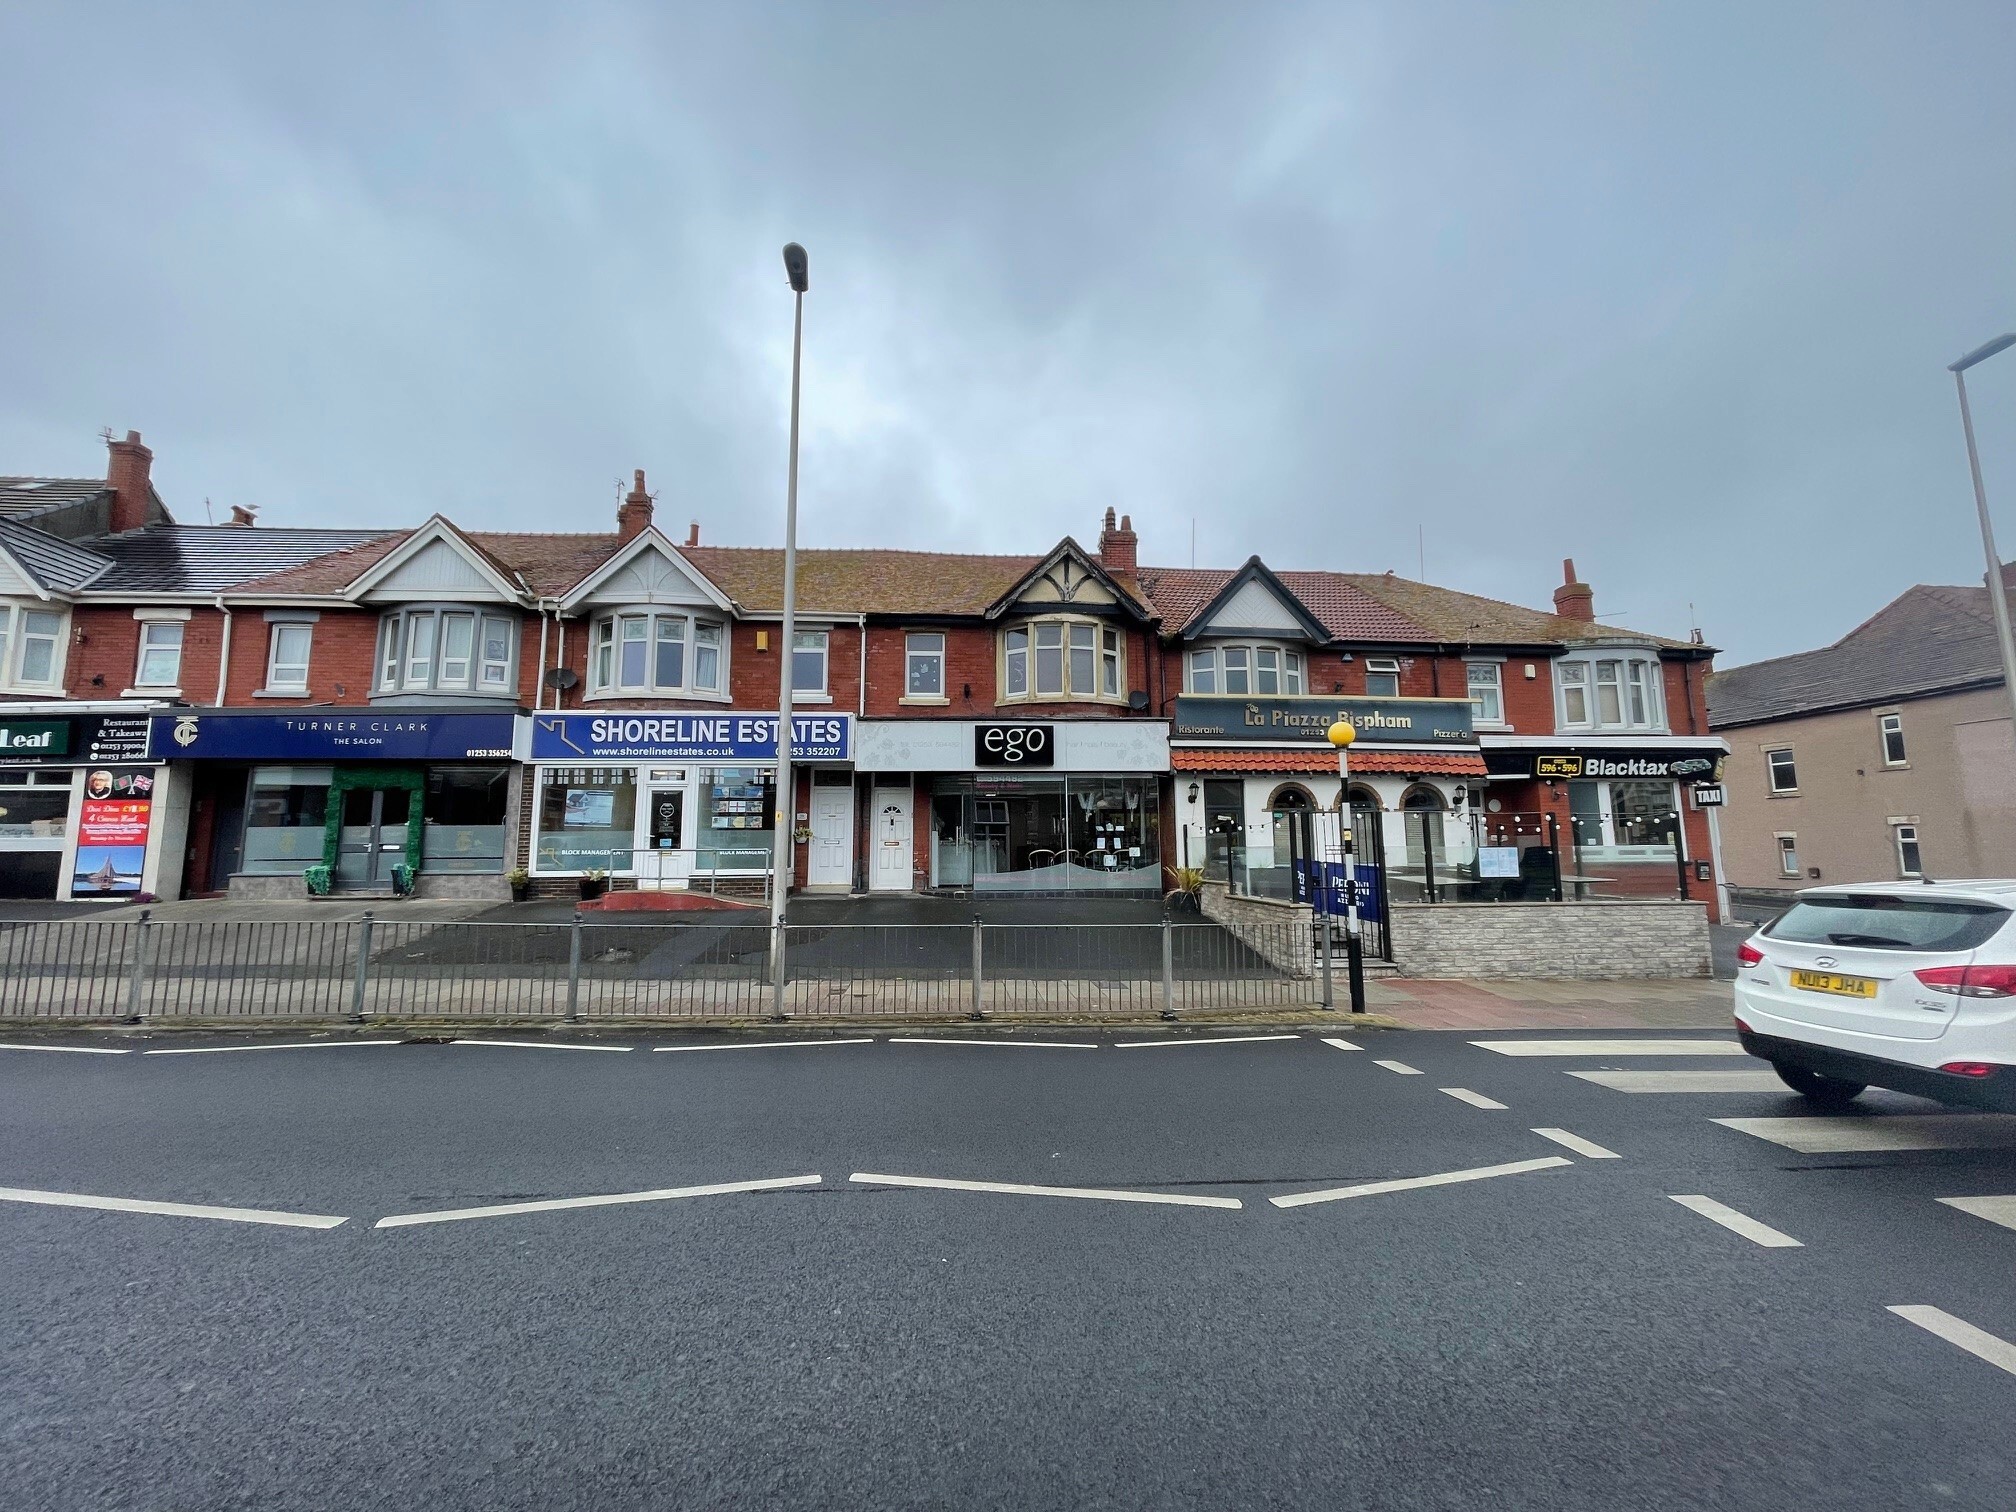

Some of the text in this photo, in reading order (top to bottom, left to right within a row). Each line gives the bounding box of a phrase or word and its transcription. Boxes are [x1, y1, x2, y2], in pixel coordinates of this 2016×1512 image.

[286, 721, 428, 732] TURNER CLARK
[1245, 709, 1411, 731] La Piazza Bispham
[97, 728, 147, 738] & Takeawa
[590, 719, 730, 743] SHORELINE
[1178, 725, 1225, 734] Ristorante
[0, 728, 53, 748] Leaf
[984, 728, 1045, 762] ego
[122, 743, 146, 751] 59004
[466, 749, 512, 757] 01253 356254
[593, 747, 734, 756] www.shorelineestates.co.uk
[806, 747, 841, 756] 352207
[1585, 759, 1668, 776] Blacktax
[1696, 789, 1721, 803] TAXI
[1798, 971, 1866, 994] NU13 JHA
